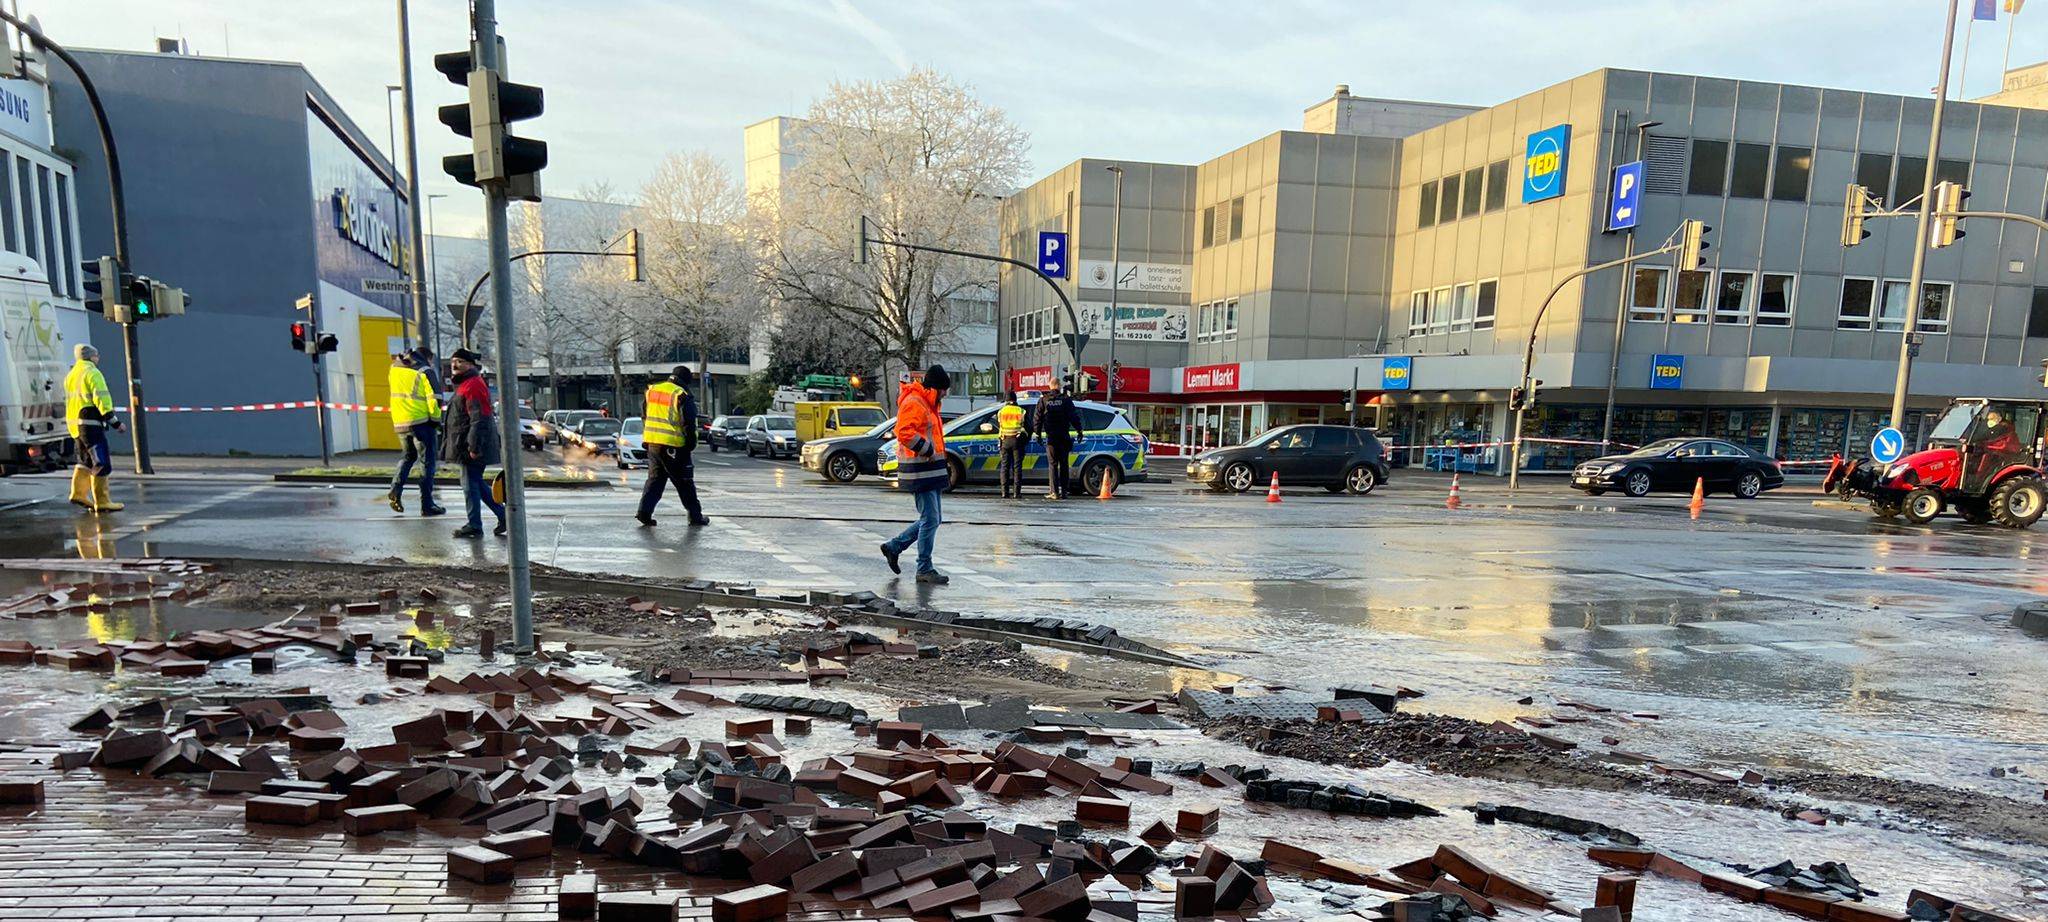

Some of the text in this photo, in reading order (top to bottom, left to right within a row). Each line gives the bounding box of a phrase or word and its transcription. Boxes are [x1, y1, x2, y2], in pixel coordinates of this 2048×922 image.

[1527, 150, 1560, 179] TEDi
[1619, 174, 1634, 199] P
[1046, 238, 1059, 256] P
[365, 280, 411, 294] Westring
[1187, 368, 1234, 388] Lemmi Markt
[1384, 367, 1408, 379] TEDi
[1656, 365, 1681, 377] TEDi
[1019, 372, 1035, 388] Lemmi
